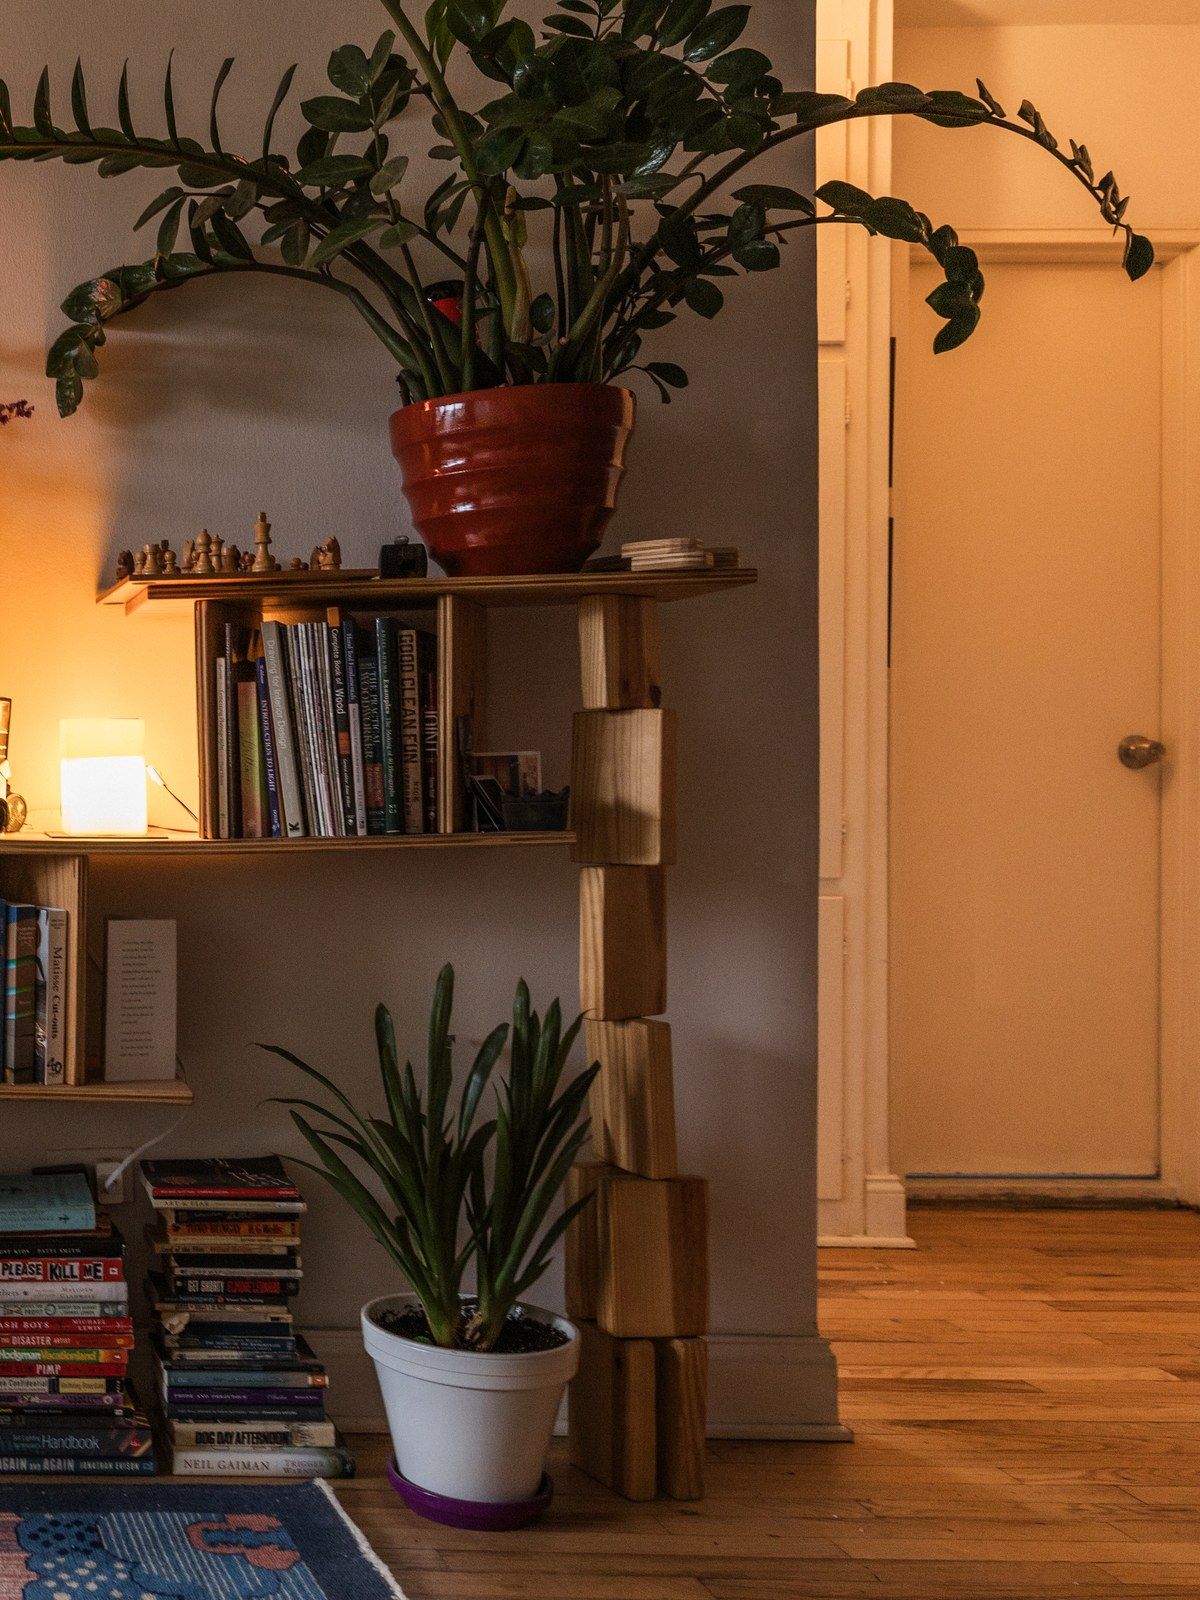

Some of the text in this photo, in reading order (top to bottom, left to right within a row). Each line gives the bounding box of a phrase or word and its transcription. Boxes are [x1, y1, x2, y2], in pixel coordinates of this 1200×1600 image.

[330, 628, 341, 659] Complete
[334, 660, 342, 677] Book
[266, 640, 288, 750] Drawing for Interior Design
[334, 688, 346, 714] Wood
[398, 634, 418, 764] GOOD CLEAN FUN
[51, 946, 63, 1040] Matisse Cut-outs
[0, 1262, 102, 1280] PLEASE KILL ME
[22, 1320, 50, 1329] BOYS
[11, 1336, 52, 1346] DISASTER
[36, 1364, 62, 1376] PIMP
[42, 1434, 100, 1450] Handbook
[196, 1430, 290, 1445] DOG DAY AFTERNOON
[42, 1458, 74, 1472] AGAIN
[184, 1458, 270, 1472] NEIL GAIMAN
